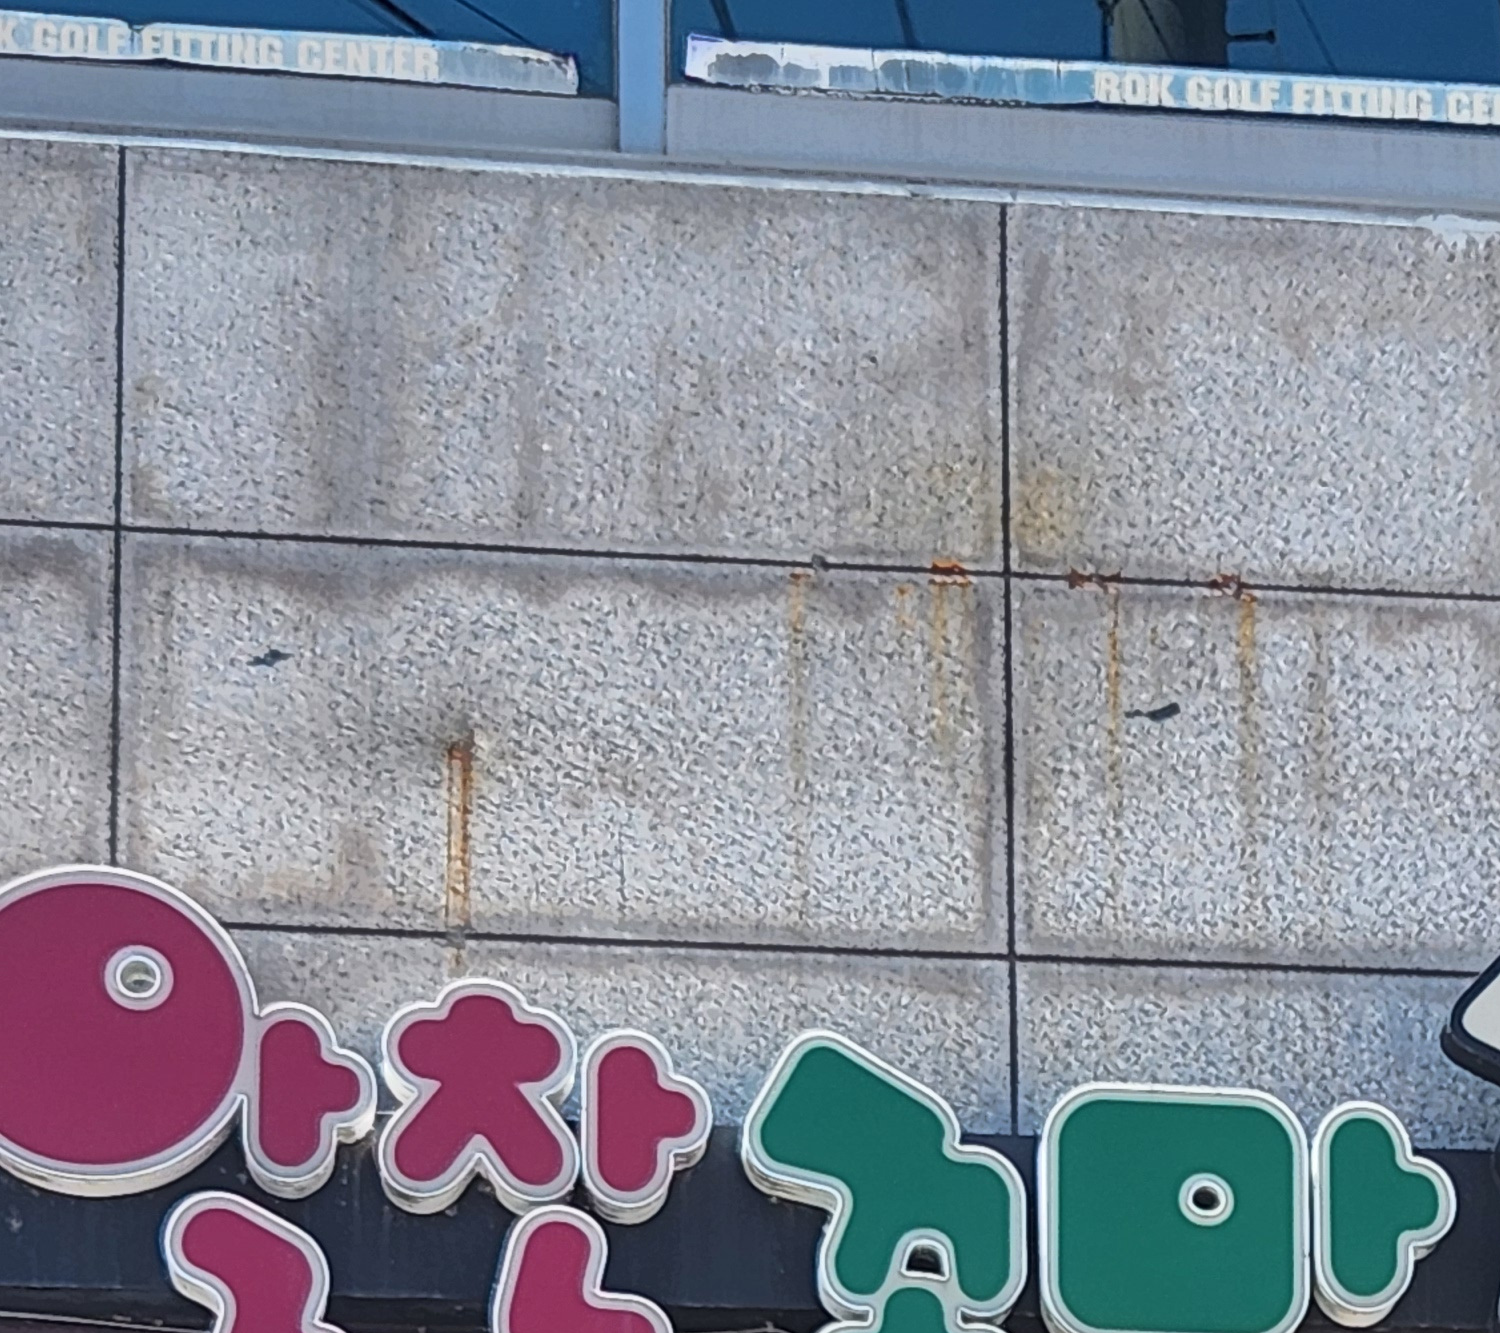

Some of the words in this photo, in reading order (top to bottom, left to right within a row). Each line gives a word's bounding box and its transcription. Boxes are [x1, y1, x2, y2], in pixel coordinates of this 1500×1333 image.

[142, 28, 284, 67] FITTING
[298, 38, 441, 81] CENTER
[1095, 70, 1174, 106] ROK
[1186, 75, 1281, 112] GOLF
[1292, 81, 1434, 121] FITTING
